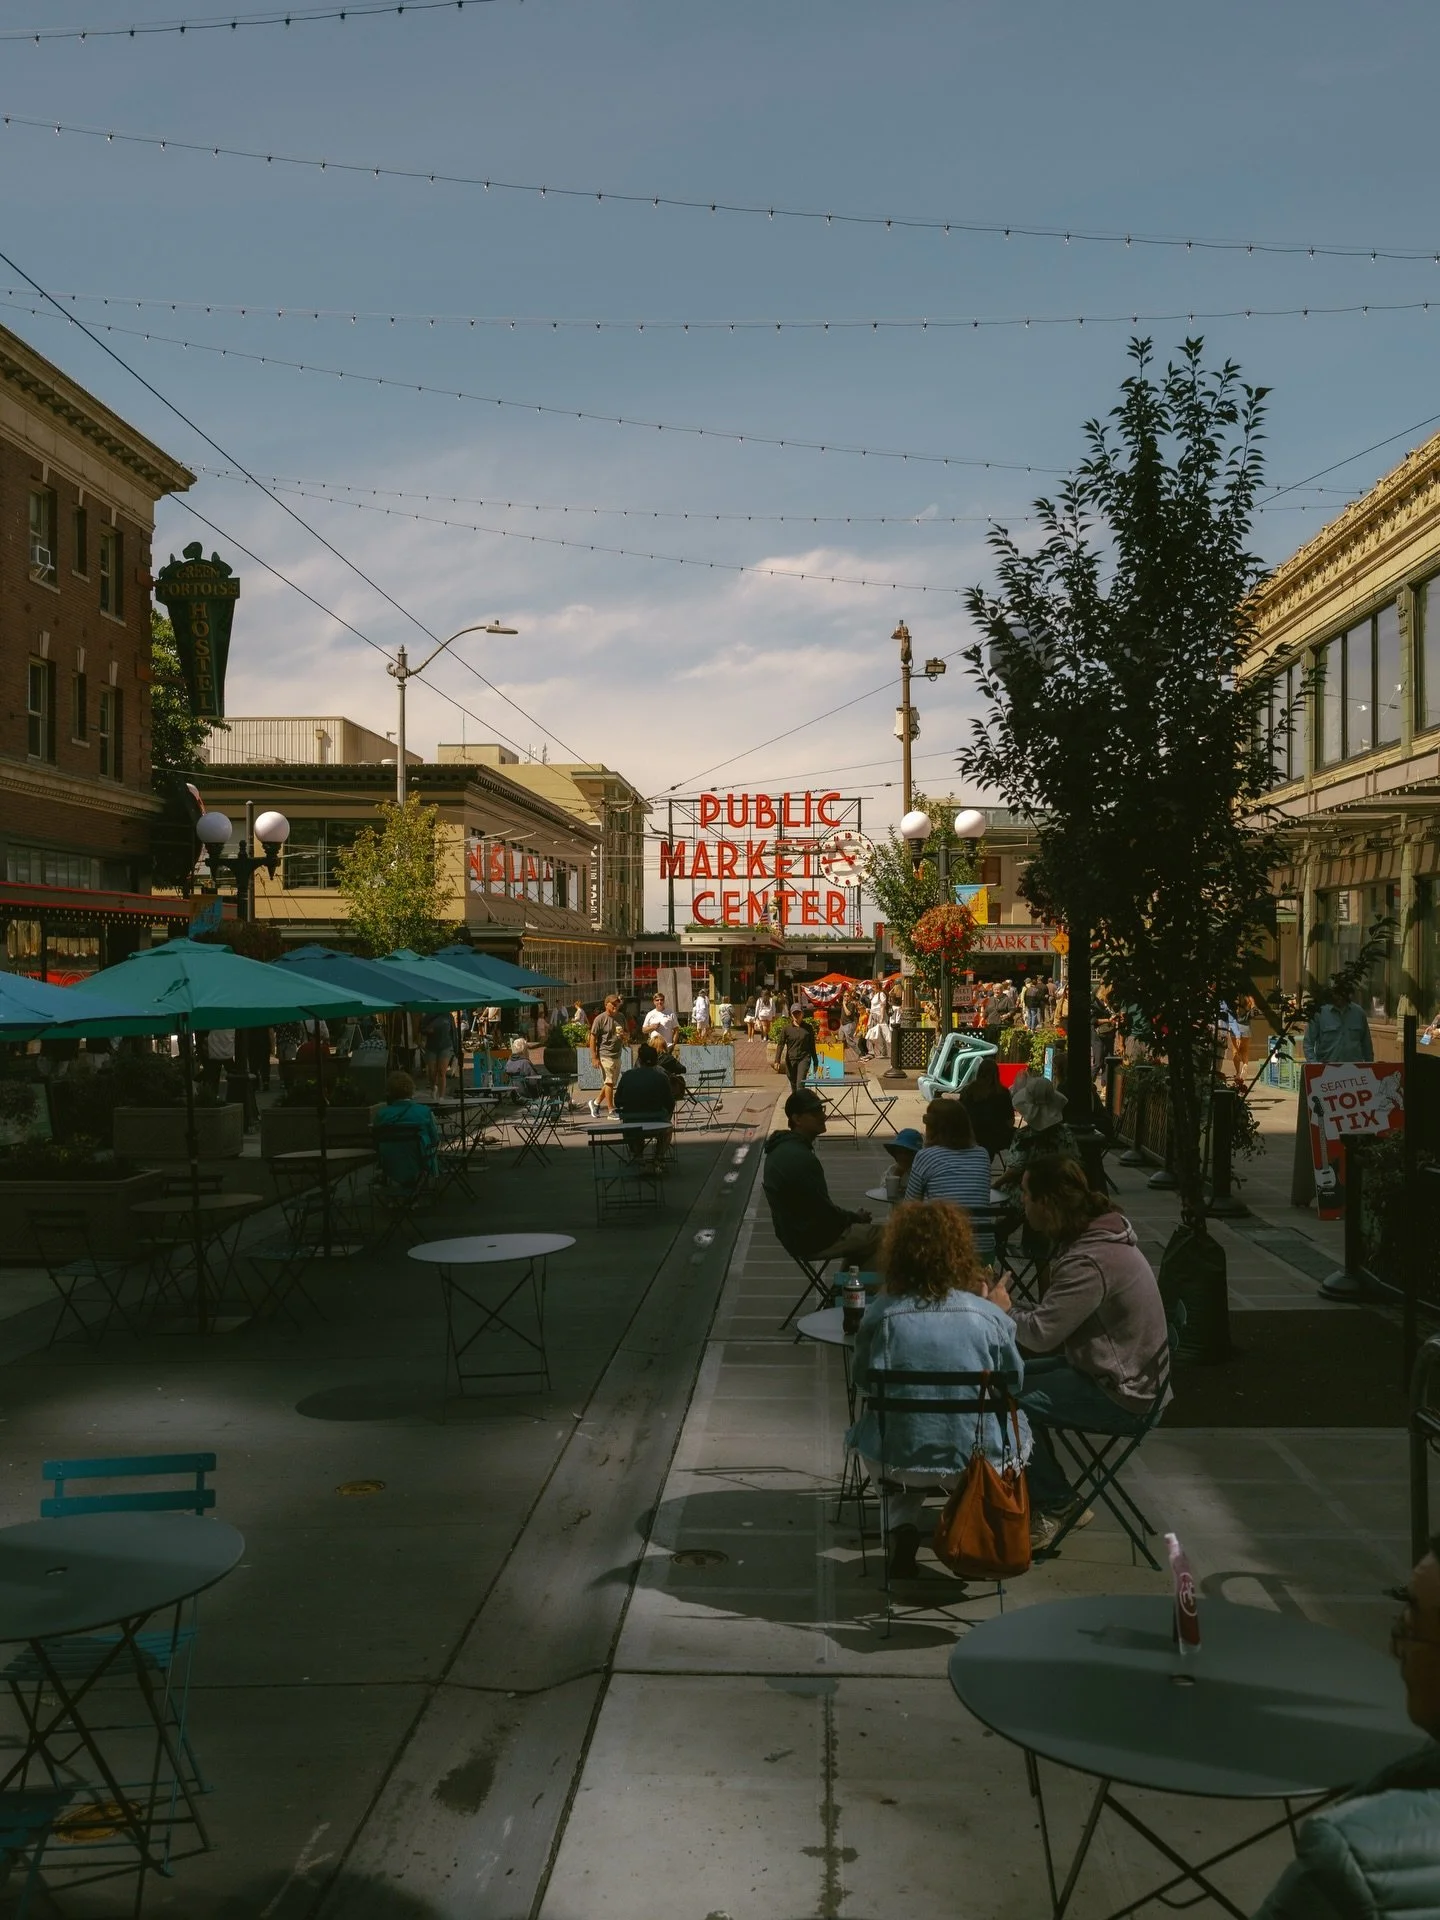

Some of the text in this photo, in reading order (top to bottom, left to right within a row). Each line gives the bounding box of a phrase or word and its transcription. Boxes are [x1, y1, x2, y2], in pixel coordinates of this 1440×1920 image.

[176, 565, 220, 578] GREEN
[163, 582, 237, 596] TORTOISE
[190, 602, 213, 710] HOSTEL
[700, 793, 840, 828] PUBLIC
[660, 840, 819, 879] MARKET
[692, 891, 846, 925] CENTER
[980, 935, 1052, 950] MARKET
[1321, 1077, 1368, 1092] SEATTLE
[1323, 1089, 1372, 1112] TOP
[1329, 1108, 1380, 1132] TIX
